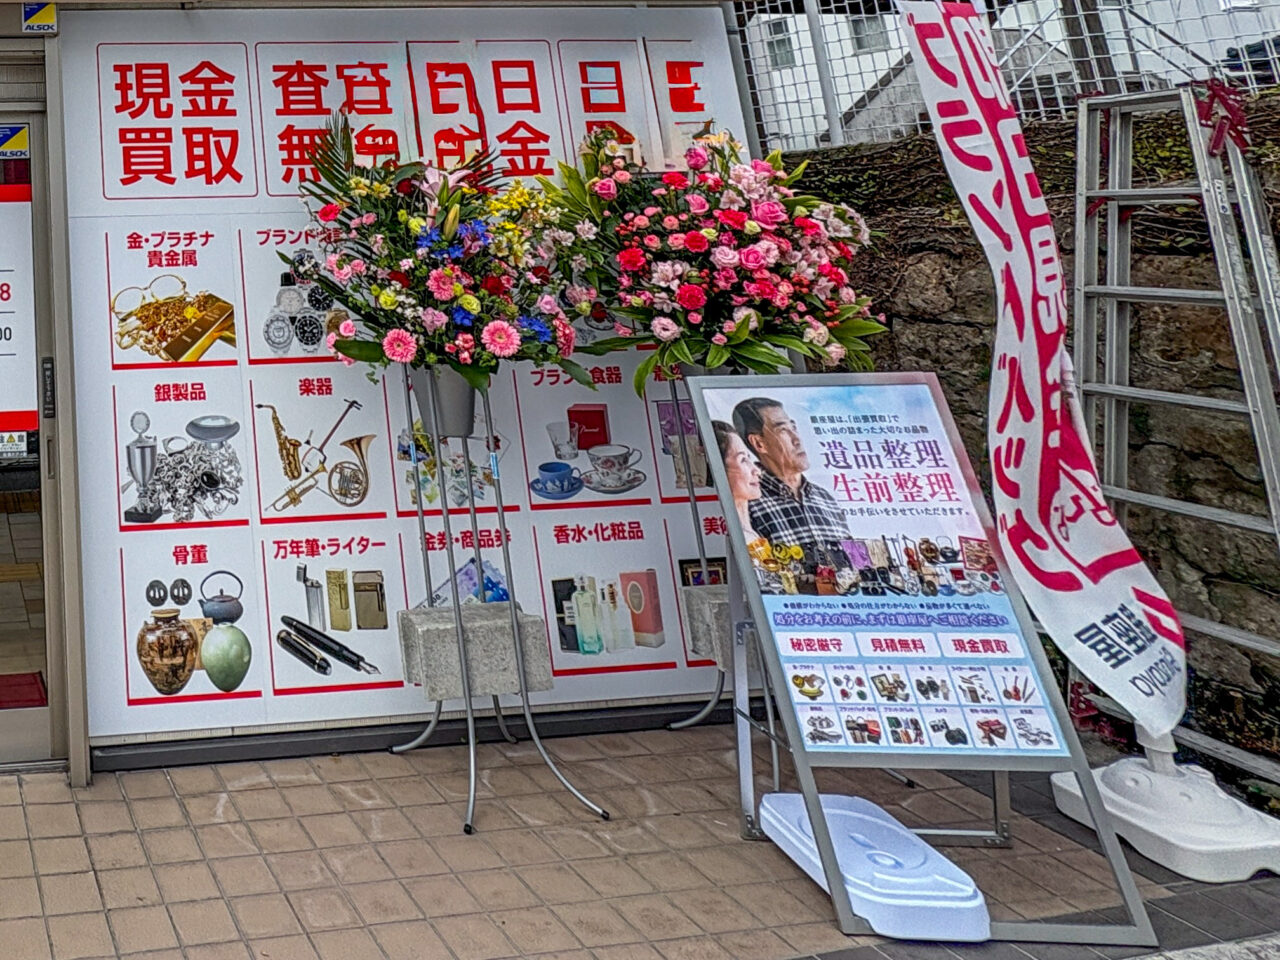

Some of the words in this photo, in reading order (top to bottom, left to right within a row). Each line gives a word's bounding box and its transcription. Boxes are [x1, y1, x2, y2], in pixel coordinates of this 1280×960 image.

[24, 23, 56, 32] ALSOK
[113, 60, 238, 120] 現金
[119, 126, 244, 187] 買取
[126, 230, 216, 250] 金・プラチナ
[256, 228, 344, 247] ブランド
[147, 249, 199, 268] 貴金属
[298, 377, 334, 397] 楽器
[530, 366, 623, 387] ブラン食器
[154, 382, 207, 403] 銀製品
[819, 439, 949, 469] 遺品整理
[833, 471, 962, 504] 生前整理
[553, 521, 644, 545] 香水・化粧品
[172, 544, 209, 566] 骨董
[272, 536, 387, 560] 万年筆・ライター
[871, 638, 926, 653] 見積無料
[954, 638, 1010, 653] 現金買取
